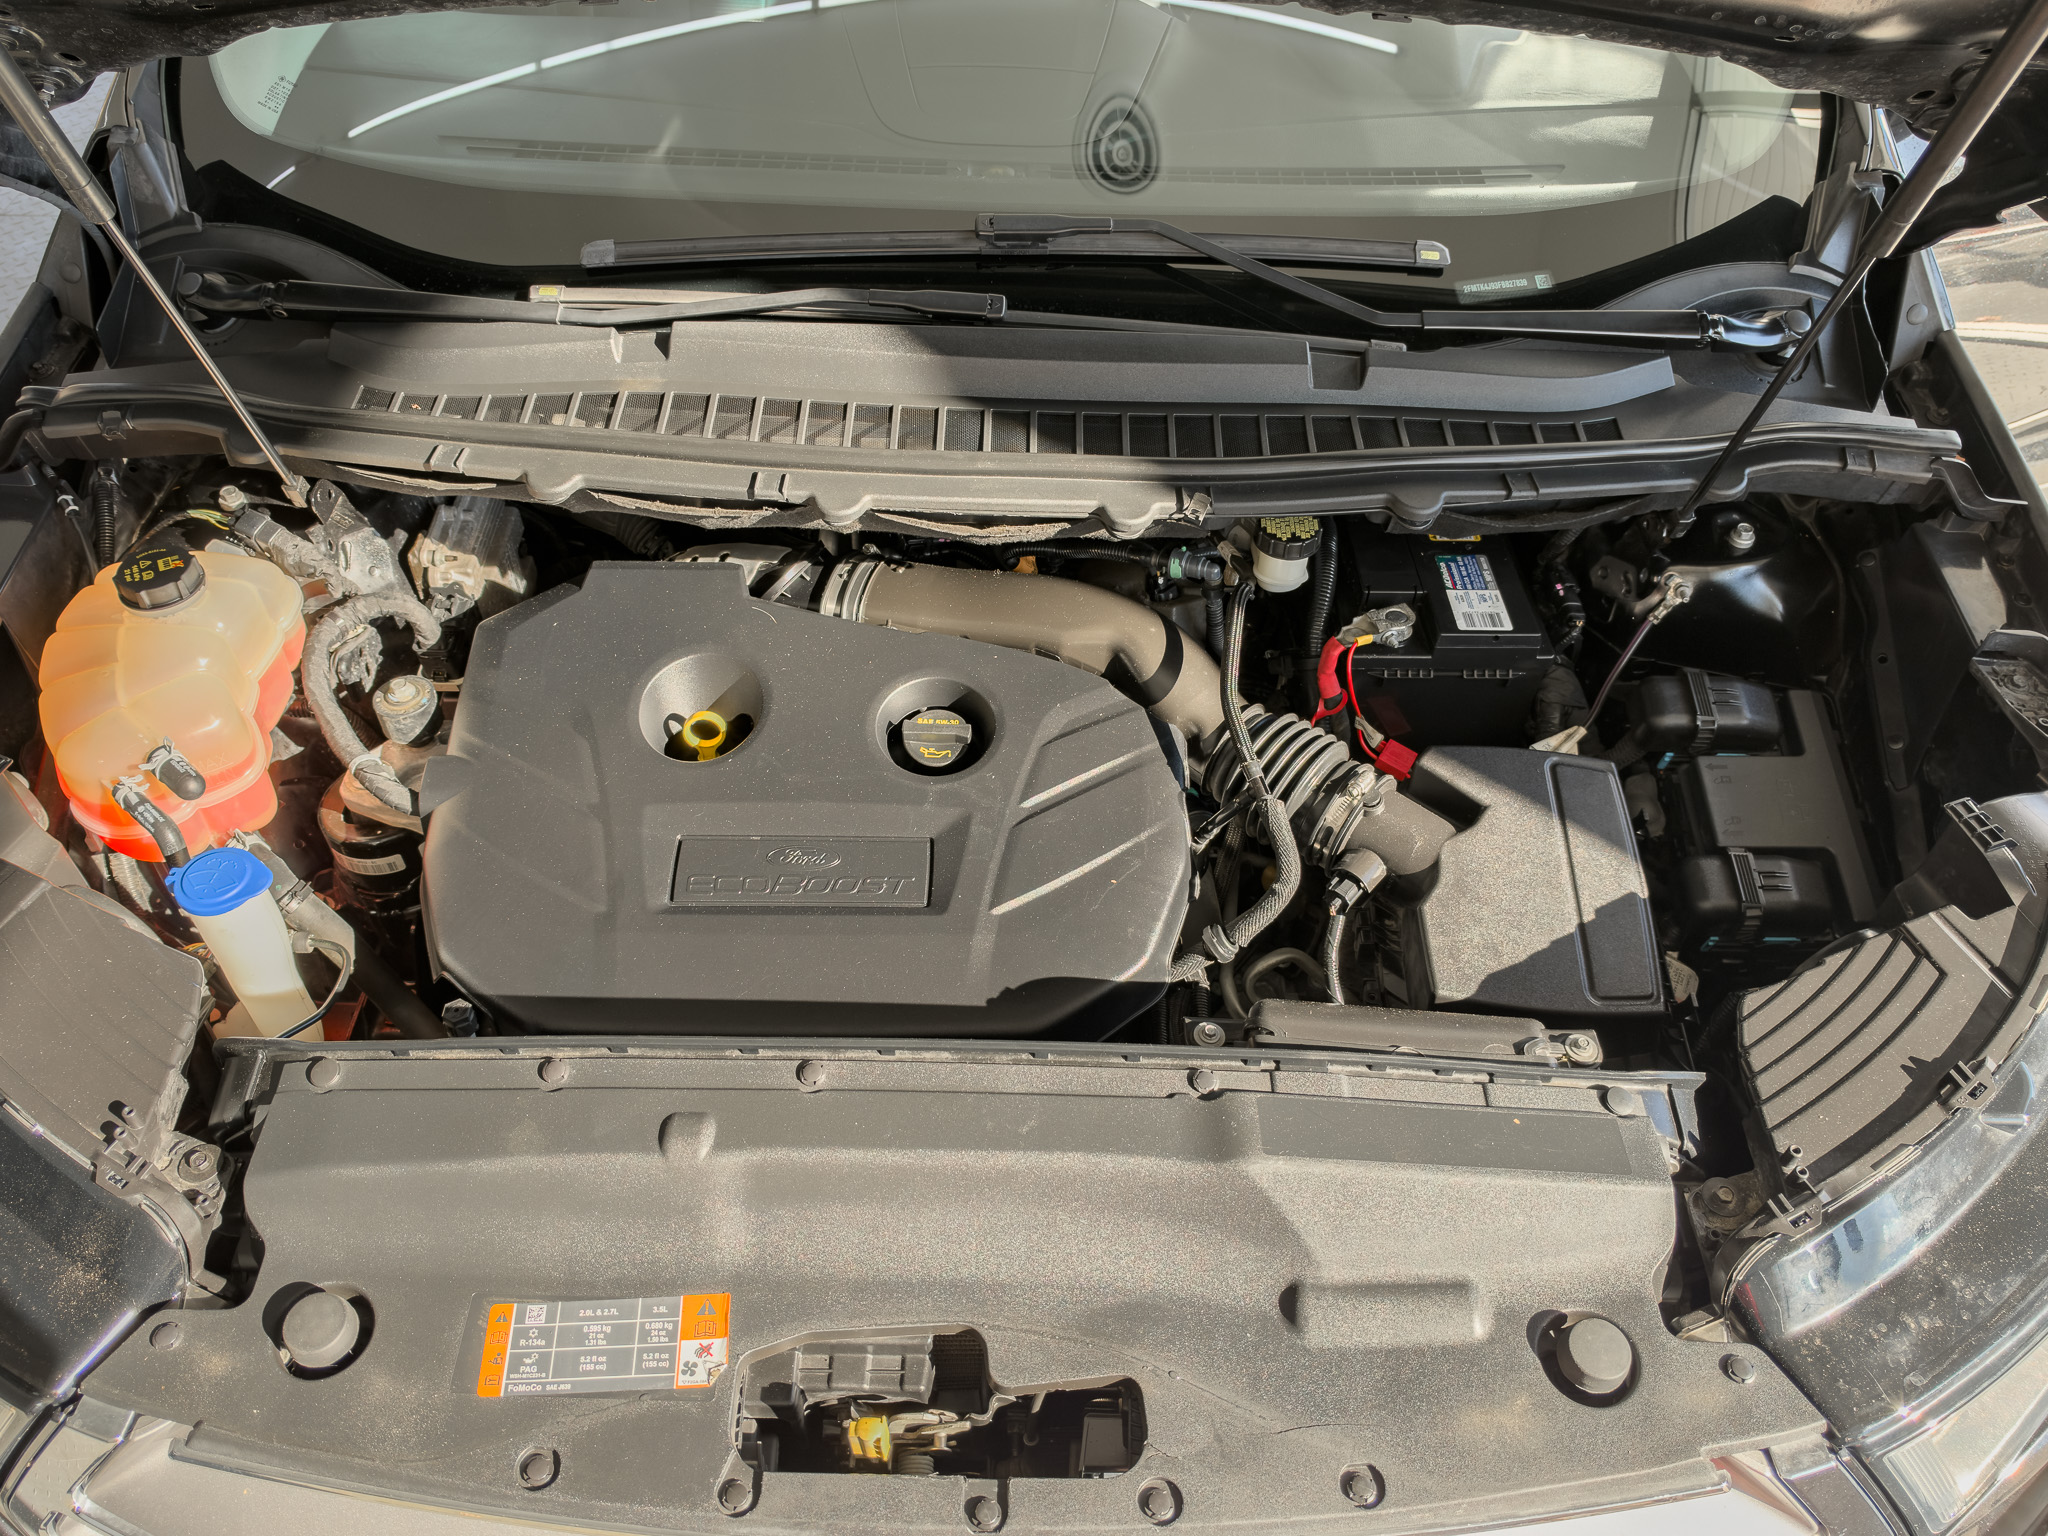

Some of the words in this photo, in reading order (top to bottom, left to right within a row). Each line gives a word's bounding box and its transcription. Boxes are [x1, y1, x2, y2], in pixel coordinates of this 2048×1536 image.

[1463, 278, 1528, 293] 2FMTK4J93FBB27839
[780, 849, 827, 865] Ford
[604, 1308, 618, 1316] 2.7L
[602, 1325, 611, 1333] kg
[664, 1322, 673, 1330] kg
[580, 1364, 594, 1372] (155
[596, 1363, 606, 1371] cc)
[658, 1360, 669, 1368] cc)
[508, 1384, 542, 1392] FoMoCo
